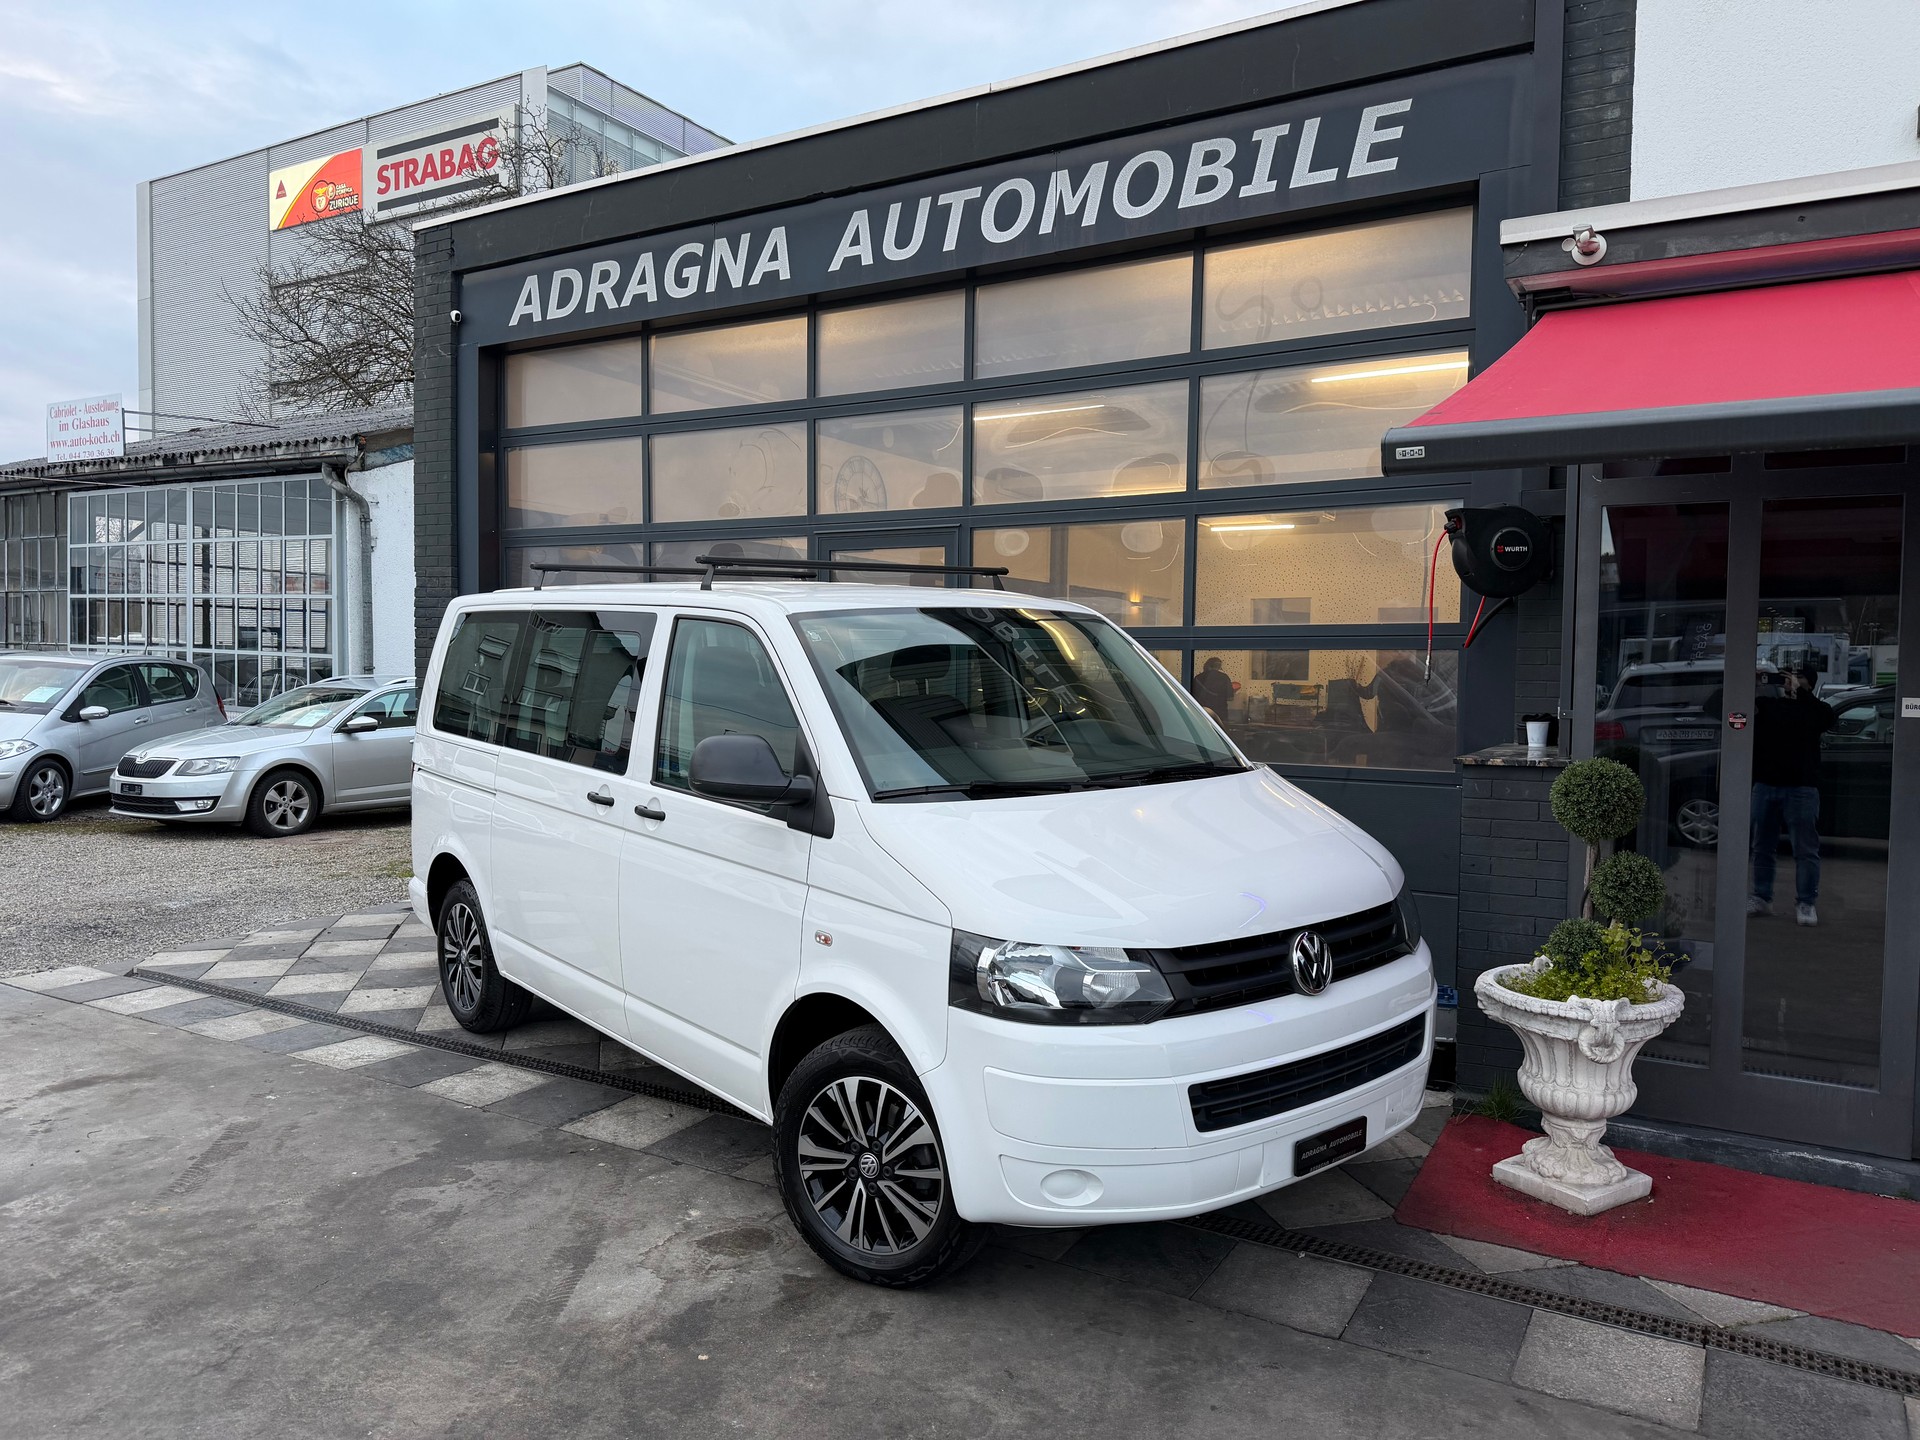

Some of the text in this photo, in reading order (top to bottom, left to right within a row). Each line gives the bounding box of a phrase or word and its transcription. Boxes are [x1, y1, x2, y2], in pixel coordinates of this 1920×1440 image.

[377, 137, 499, 195] STRABAG
[329, 195, 359, 211] ZURIQUE
[509, 98, 1414, 327] ADRAGNA AUTOMOBILE
[49, 404, 77, 419] Cabriolet
[84, 399, 119, 414] Ausstellung
[59, 416, 109, 432] im Glashaus
[50, 430, 120, 449] www.auto-koch.ch
[56, 448, 115, 461] Tel. 044 730 36 36
[1301, 1128, 1364, 1160] ADRAGNA AUTOMOBILE
